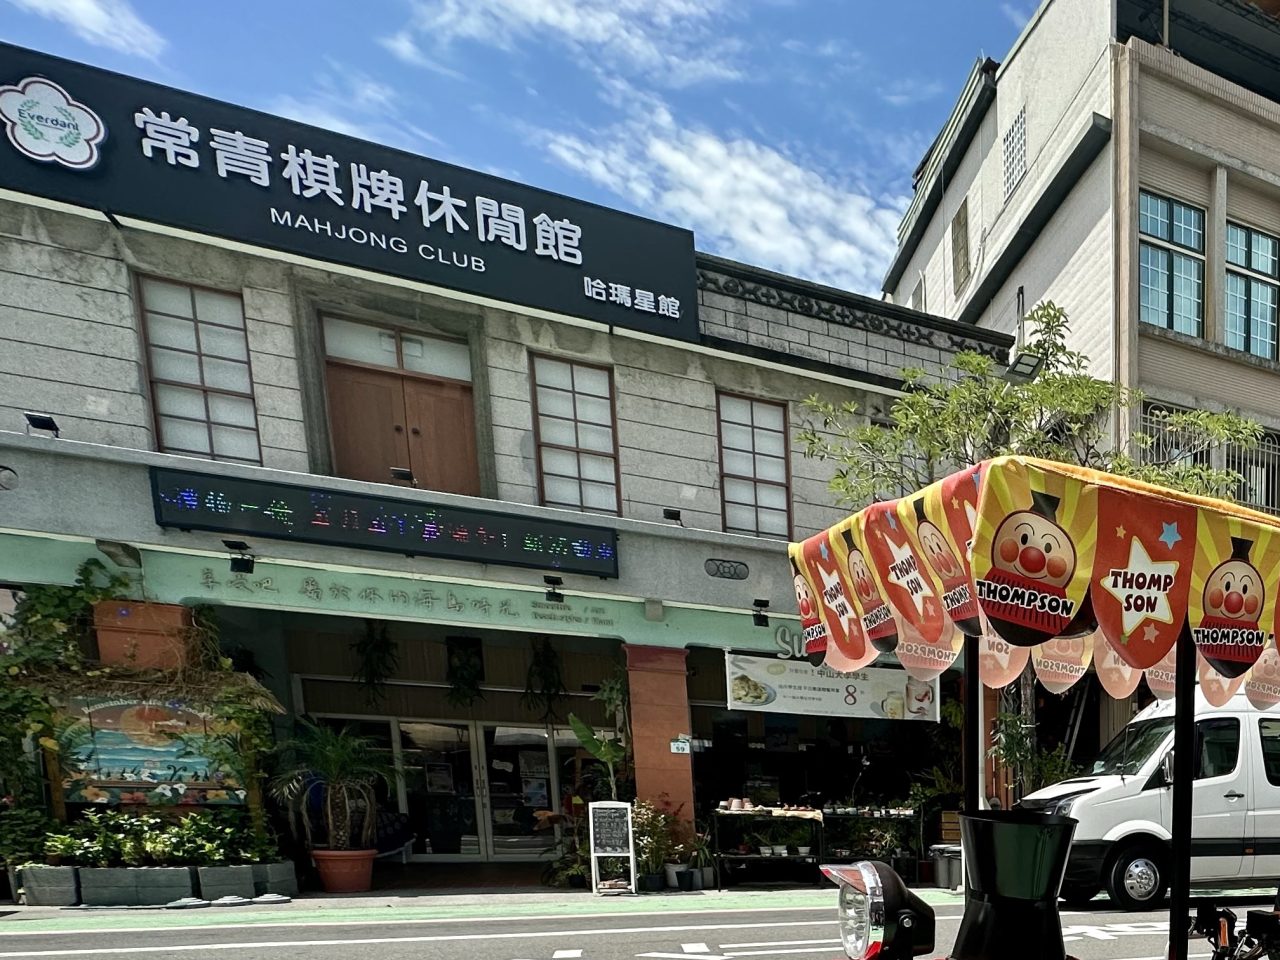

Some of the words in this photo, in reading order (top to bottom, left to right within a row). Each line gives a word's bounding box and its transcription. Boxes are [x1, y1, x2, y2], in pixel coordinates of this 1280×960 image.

[134, 107, 582, 265] 常青棋牌休閒館
[269, 207, 408, 253] MAHJONG
[418, 244, 486, 272] CLUB
[583, 276, 681, 319] 哈瑪星館
[890, 555, 918, 582] THOMP
[906, 576, 924, 596] SON
[1110, 570, 1174, 593] THOMP
[976, 580, 1075, 617] THOMPSON
[1123, 594, 1158, 613] SON
[863, 605, 892, 629] THOMPSON
[1194, 628, 1264, 646] THOMPSON
[843, 684, 858, 706] 8
